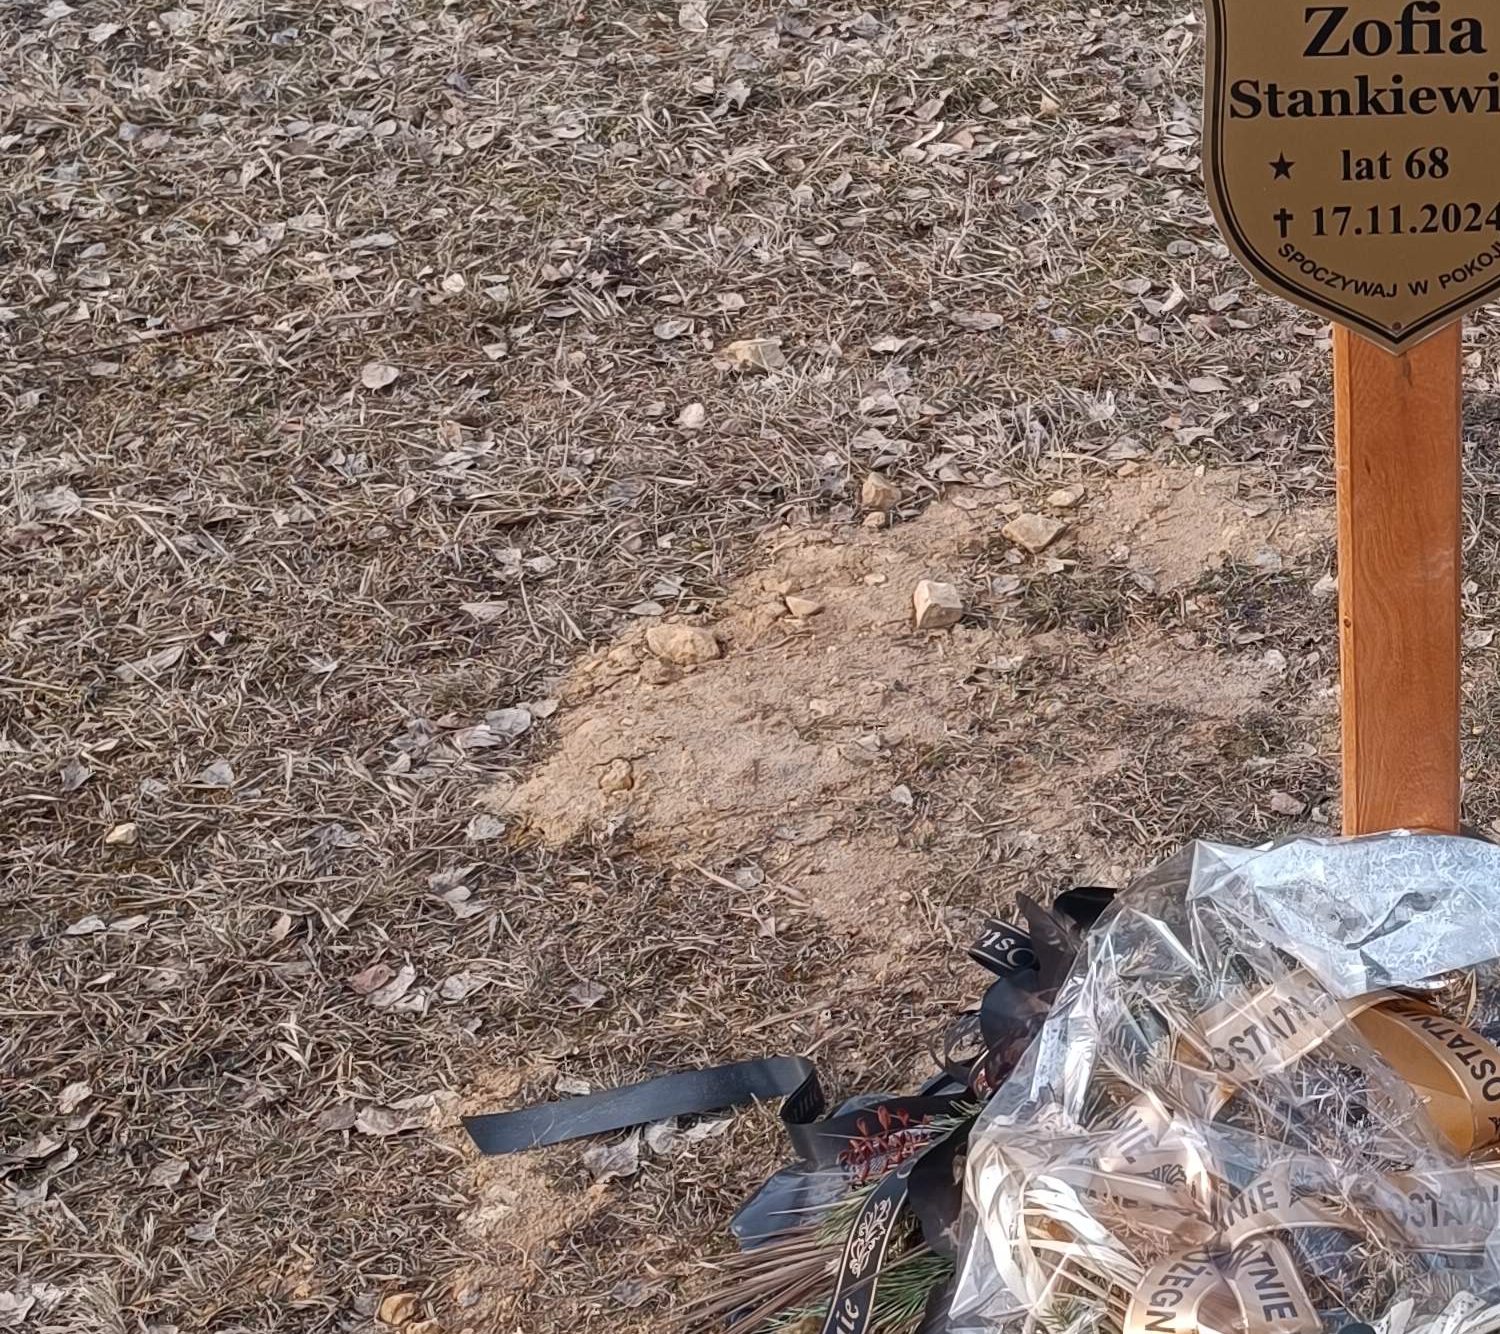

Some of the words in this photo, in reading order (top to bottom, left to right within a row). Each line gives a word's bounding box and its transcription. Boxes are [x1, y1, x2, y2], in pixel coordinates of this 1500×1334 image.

[1302, 0, 1487, 57] Zofia
[1341, 148, 1391, 181] lat
[1404, 146, 1449, 180] 68
[1277, 241, 1398, 299] SPOCZYWAJ
[1407, 279, 1429, 297] W
